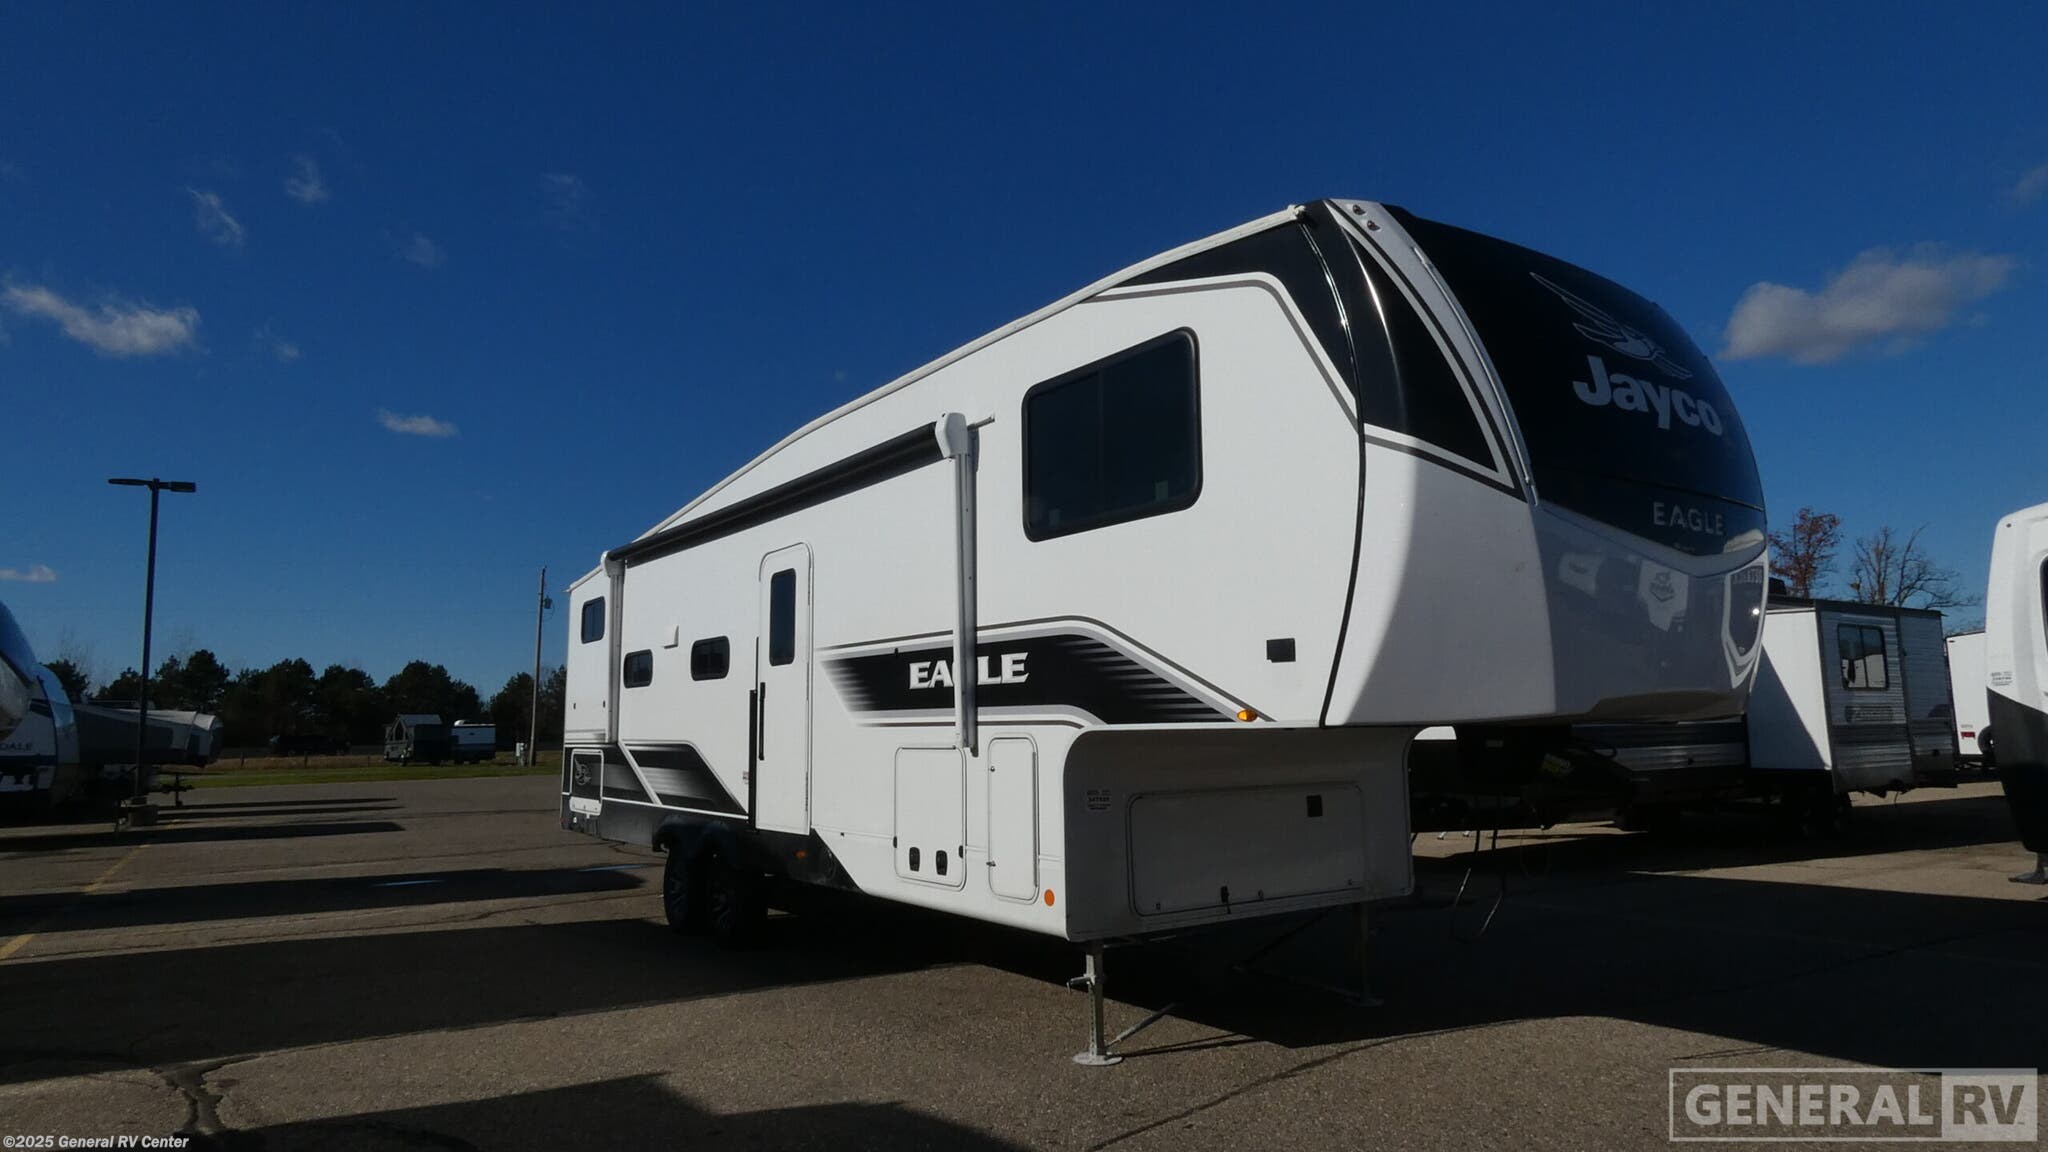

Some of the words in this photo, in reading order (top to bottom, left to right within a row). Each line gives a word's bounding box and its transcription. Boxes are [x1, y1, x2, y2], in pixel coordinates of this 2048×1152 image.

[1572, 355, 1722, 436] Jayco
[1653, 502, 1724, 536] EAGLE
[909, 652, 1029, 689] EALE
